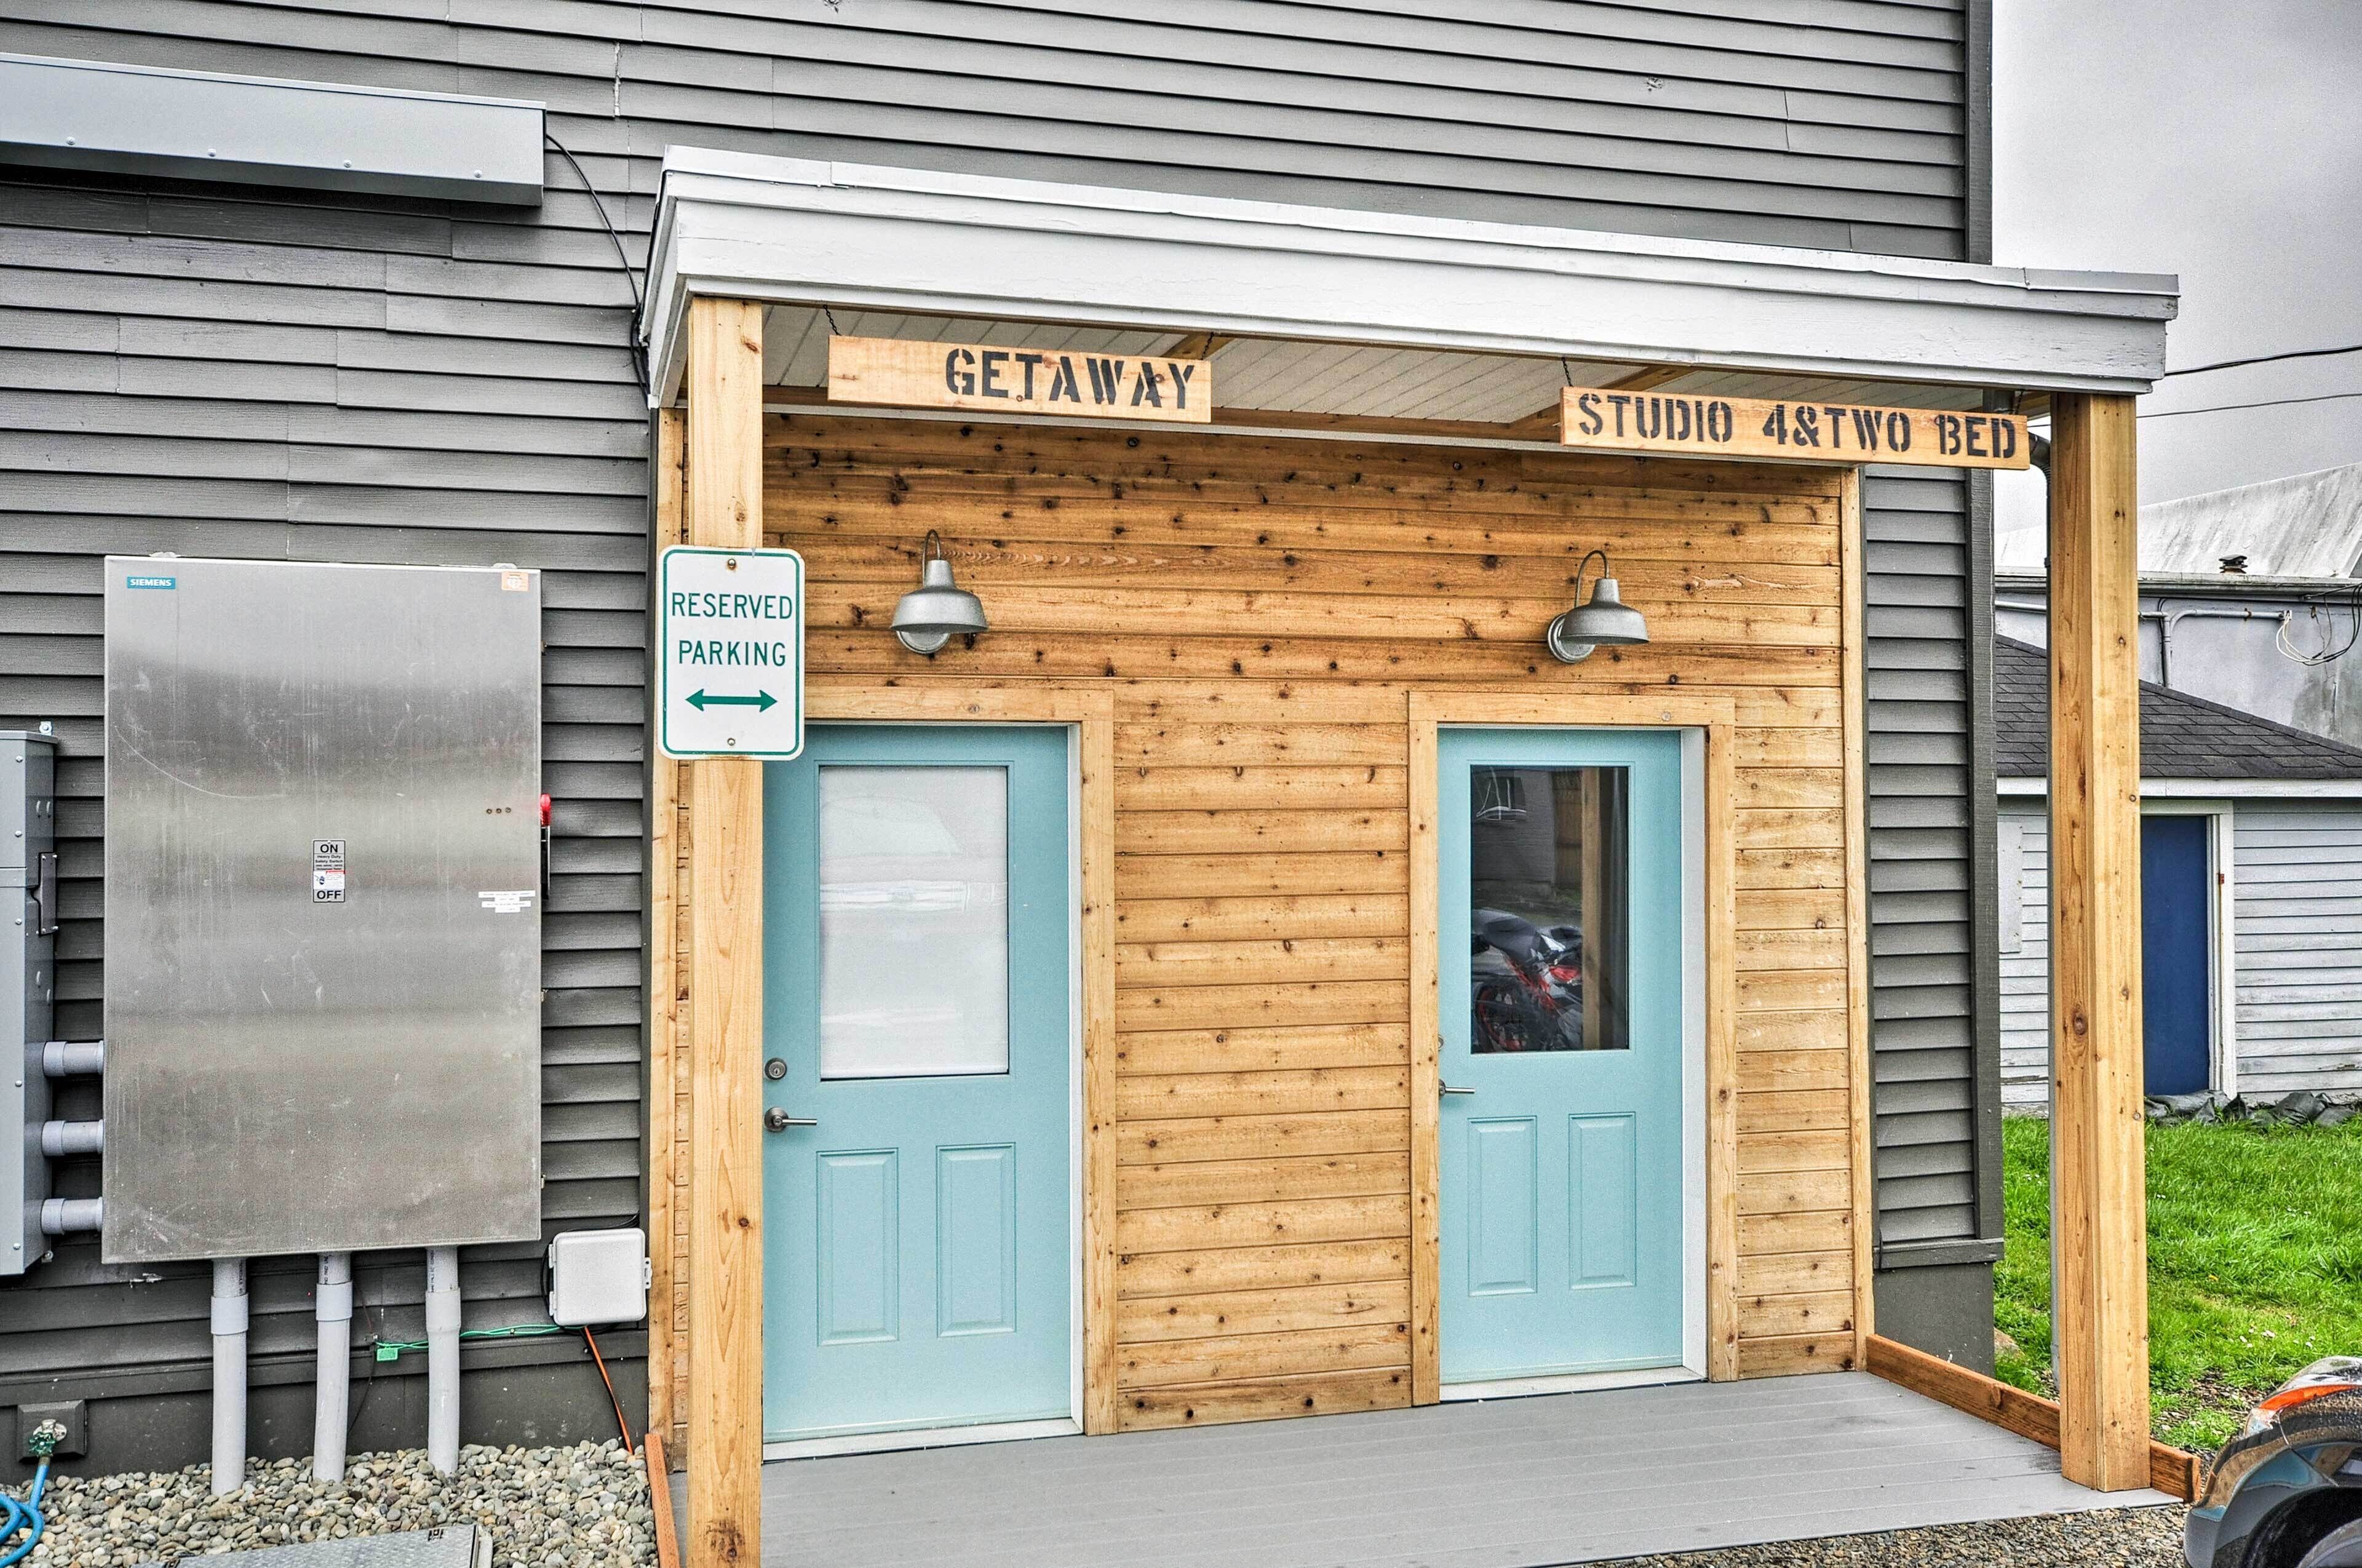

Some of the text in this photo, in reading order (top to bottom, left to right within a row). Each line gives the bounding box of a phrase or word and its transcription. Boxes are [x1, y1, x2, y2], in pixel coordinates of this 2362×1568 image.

[945, 348, 1195, 409] GETAWAY
[1578, 393, 2016, 458] STUDIO 4&TWO BED
[130, 578, 172, 587] SIEMENS
[672, 592, 793, 619] RESERVED
[678, 640, 786, 667] PARKING
[320, 844, 338, 853] ON
[317, 890, 341, 899] OFF
